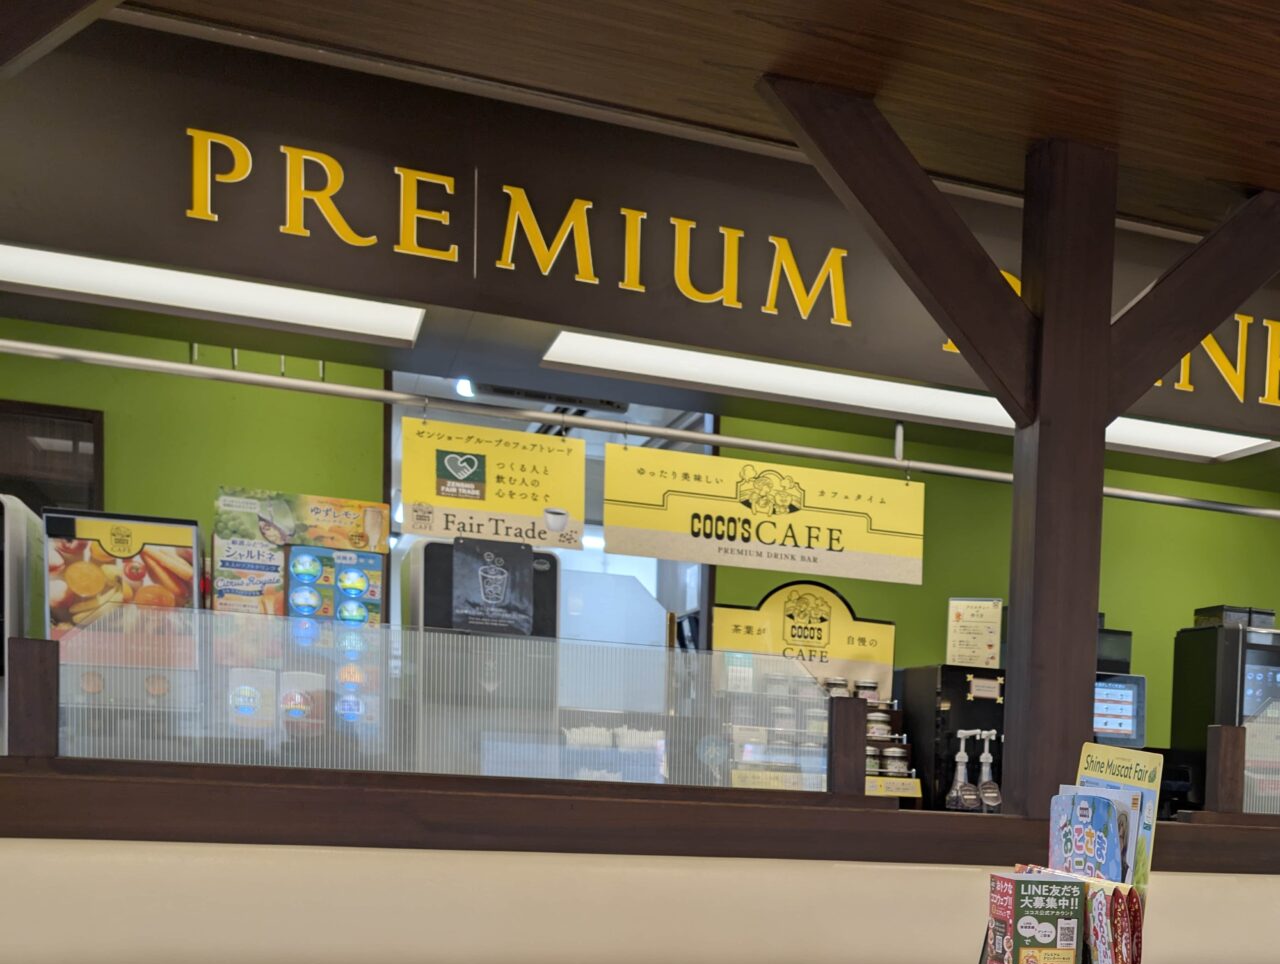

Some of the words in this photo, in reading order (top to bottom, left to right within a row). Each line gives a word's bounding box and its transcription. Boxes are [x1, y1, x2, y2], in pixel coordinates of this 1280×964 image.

[185, 127, 852, 328] PREMIUM
[495, 461, 551, 476] つくる人と
[443, 513, 485, 535] Fair
[488, 517, 549, 541] Trade
[690, 512, 752, 544] COCO'S
[754, 520, 845, 553] CAFE
[224, 546, 277, 561] シャルドネ
[717, 546, 764, 558] PREMIUM
[766, 551, 797, 562] DRINK
[800, 554, 820, 564] BAR
[790, 625, 823, 641] COCO'S
[782, 647, 830, 665] CAFE
[1083, 754, 1106, 774] Shine
[1104, 759, 1133, 779] Muscat
[1132, 763, 1149, 782] Fair
[1062, 825, 1108, 864] おこさま
[1020, 884, 1081, 897] LINE友だち
[1020, 896, 1079, 910] 大募集中!!
